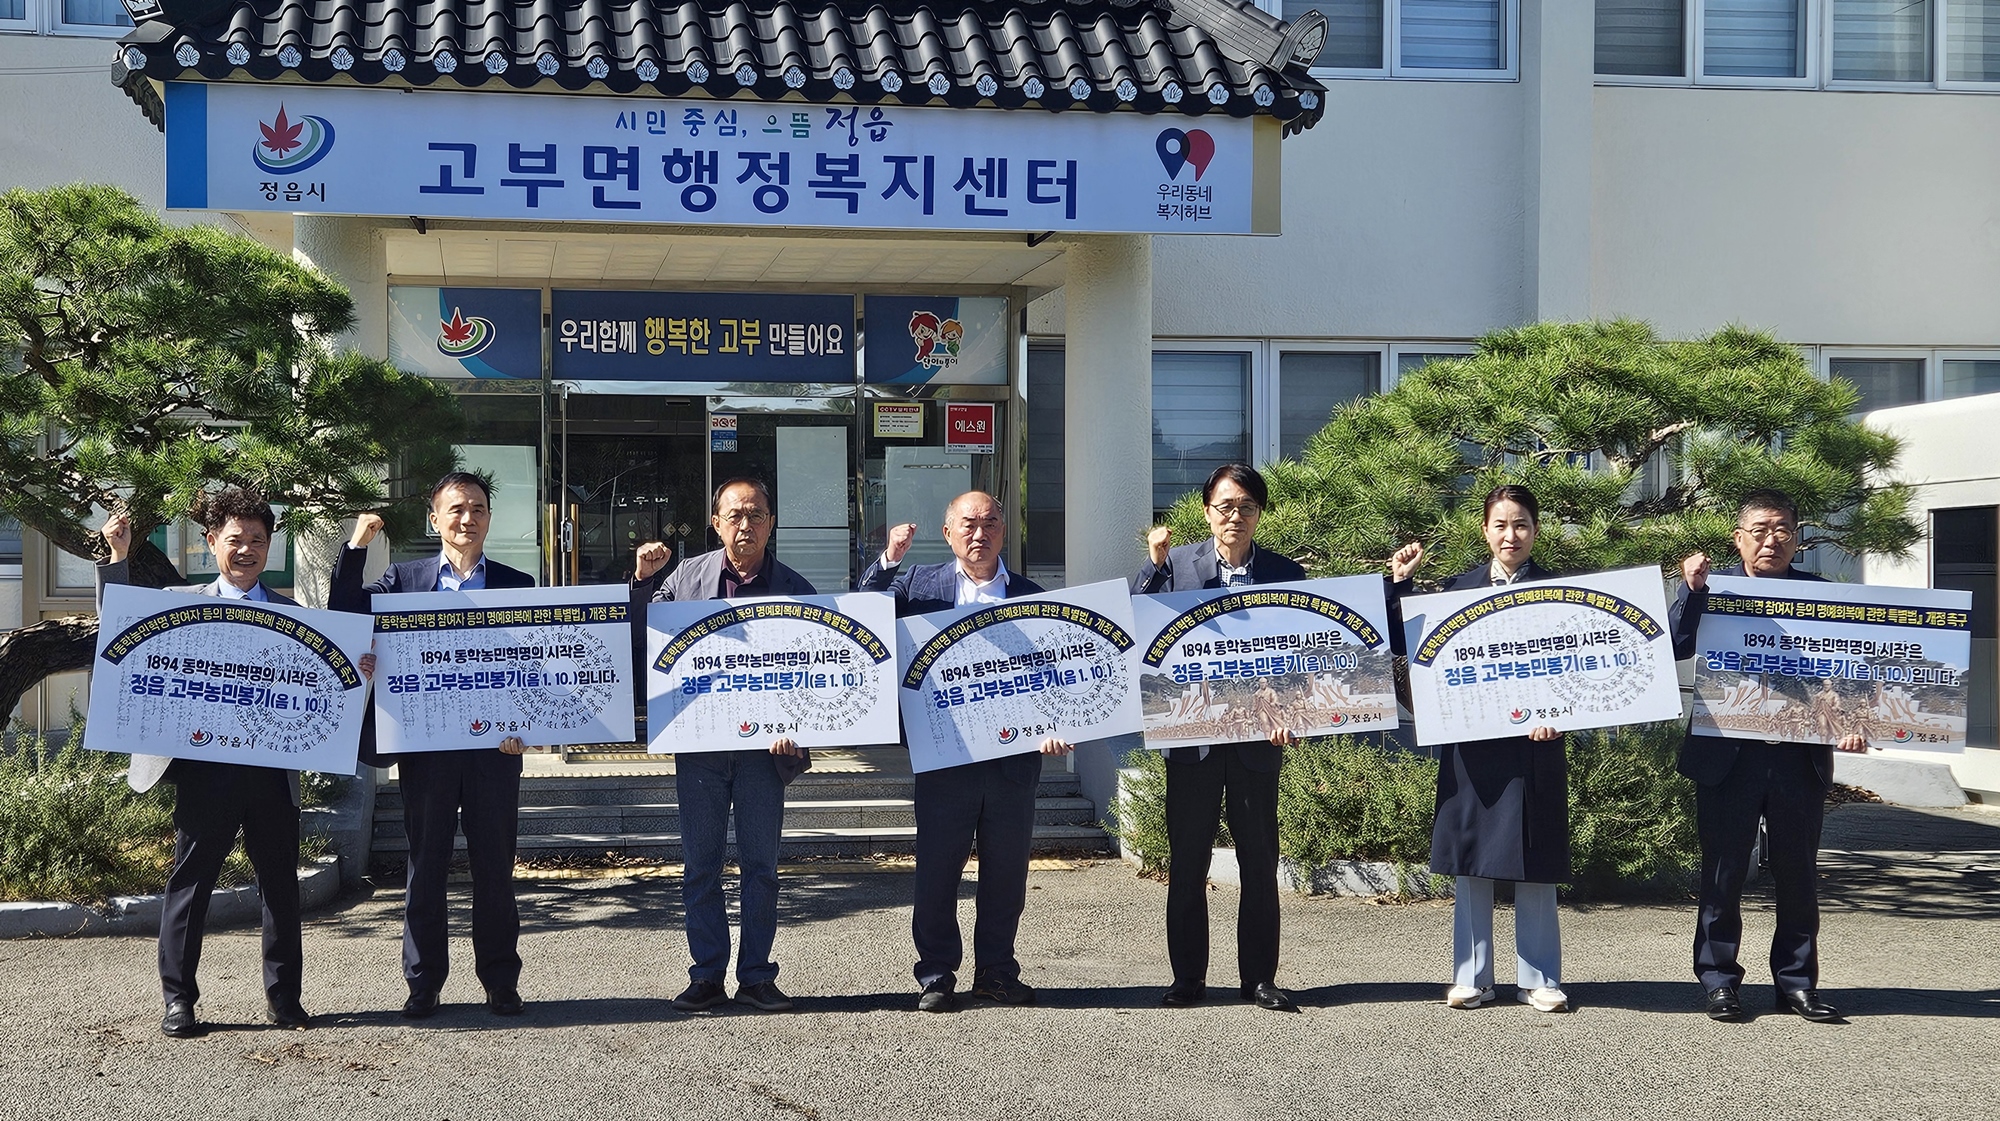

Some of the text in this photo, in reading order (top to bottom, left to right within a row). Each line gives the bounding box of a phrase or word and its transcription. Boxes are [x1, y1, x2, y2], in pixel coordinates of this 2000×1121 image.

[615, 106, 894, 147] 시민 중심, 으뜸 정읍
[259, 181, 326, 203] 정읍시
[419, 142, 1078, 220] 고부면행정복지센터
[1157, 183, 1213, 204] 우리동네
[1157, 203, 1213, 221] 복지허브
[560, 317, 844, 356] 우리함께 행복한 고부 만들어요
[954, 420, 986, 433] 에스원
[437, 613, 465, 627] 참여자
[467, 612, 485, 625] 등의
[487, 610, 532, 624] 명예회복에
[534, 609, 552, 623] 관한
[589, 607, 607, 620] 개정
[608, 606, 627, 619] 촉구
[949, 618, 976, 640] 참여자
[975, 611, 994, 627] 등의
[994, 604, 1039, 621] 명예회복에
[1041, 604, 1060, 617] 관한
[1095, 617, 1114, 635] 개정
[1111, 629, 1129, 647] 촉구
[1193, 601, 1221, 622] 참여자
[1221, 595, 1241, 611] 등의
[1242, 592, 1289, 607] 명예회복에
[1290, 593, 1310, 608] 관한
[1344, 611, 1364, 630] 개정
[1359, 625, 1379, 645] 촉구
[1465, 600, 1494, 621] 참여자
[1494, 594, 1515, 609] 등의
[1515, 589, 1563, 604] 명예회복에
[1565, 589, 1585, 603] 관한
[1621, 605, 1642, 623] 개정
[1638, 618, 1658, 636] 촉구
[1765, 600, 1795, 616] 참여자
[1795, 602, 1815, 617] 등의
[1816, 603, 1865, 620] 명예회복에
[1866, 607, 1886, 622] 관한
[1925, 611, 1946, 626] 개정
[1947, 612, 1968, 627] 촉구
[755, 604, 801, 618] 명예회복에
[803, 606, 822, 620] 관한
[853, 627, 873, 645] 개정
[868, 641, 886, 659] 촉구
[1182, 630, 1342, 658] 1894 동학농민혁명의 시작은
[1454, 628, 1621, 661] 1894 동학농민혁명의 시작은
[169, 608, 200, 626] 참여자
[202, 607, 222, 620] 등의
[225, 607, 275, 627] 명예회복에
[276, 617, 296, 635] 관한
[326, 648, 346, 668] 개정
[340, 665, 357, 685] 촉구
[420, 644, 585, 665] 1894 동학농민혁명의 시작은
[692, 649, 851, 670] 1894 동학농민혁명의 시작은
[1743, 633, 1923, 660] 1894 동학농민혁명의 시작은
[146, 654, 318, 687] 1894 동학농민혁명의 시작은
[941, 642, 1097, 682] 1894 동학농민혁명의 시작은
[1171, 653, 1358, 684] 정읍 고부농민봉기(음 1. 10.)
[1444, 651, 1638, 687] 정읍 고부농민봉기(음 1. 10.)
[1705, 650, 1959, 686] 정읍 고부농민봉기(음 1. 10.)입니다.
[130, 673, 329, 714] 정읍 고부농민봉기(음 1. 10.)
[387, 669, 620, 693] 정읍 고부농민봉기(음 1. 10.)입니다.
[681, 671, 864, 695] 정읍 고부농민봉기(음 1. 10.)
[933, 664, 1112, 708] 정읍 고부농민봉기(음 1. 10.)
[1351, 712, 1382, 723] 정읍시
[1535, 705, 1574, 719] 정읍시
[495, 720, 531, 732] 정읍시
[762, 722, 799, 733] 정읍시
[1022, 722, 1057, 737] 정읍시
[1916, 732, 1951, 744] 정읍시
[216, 733, 257, 750] 정읍시
